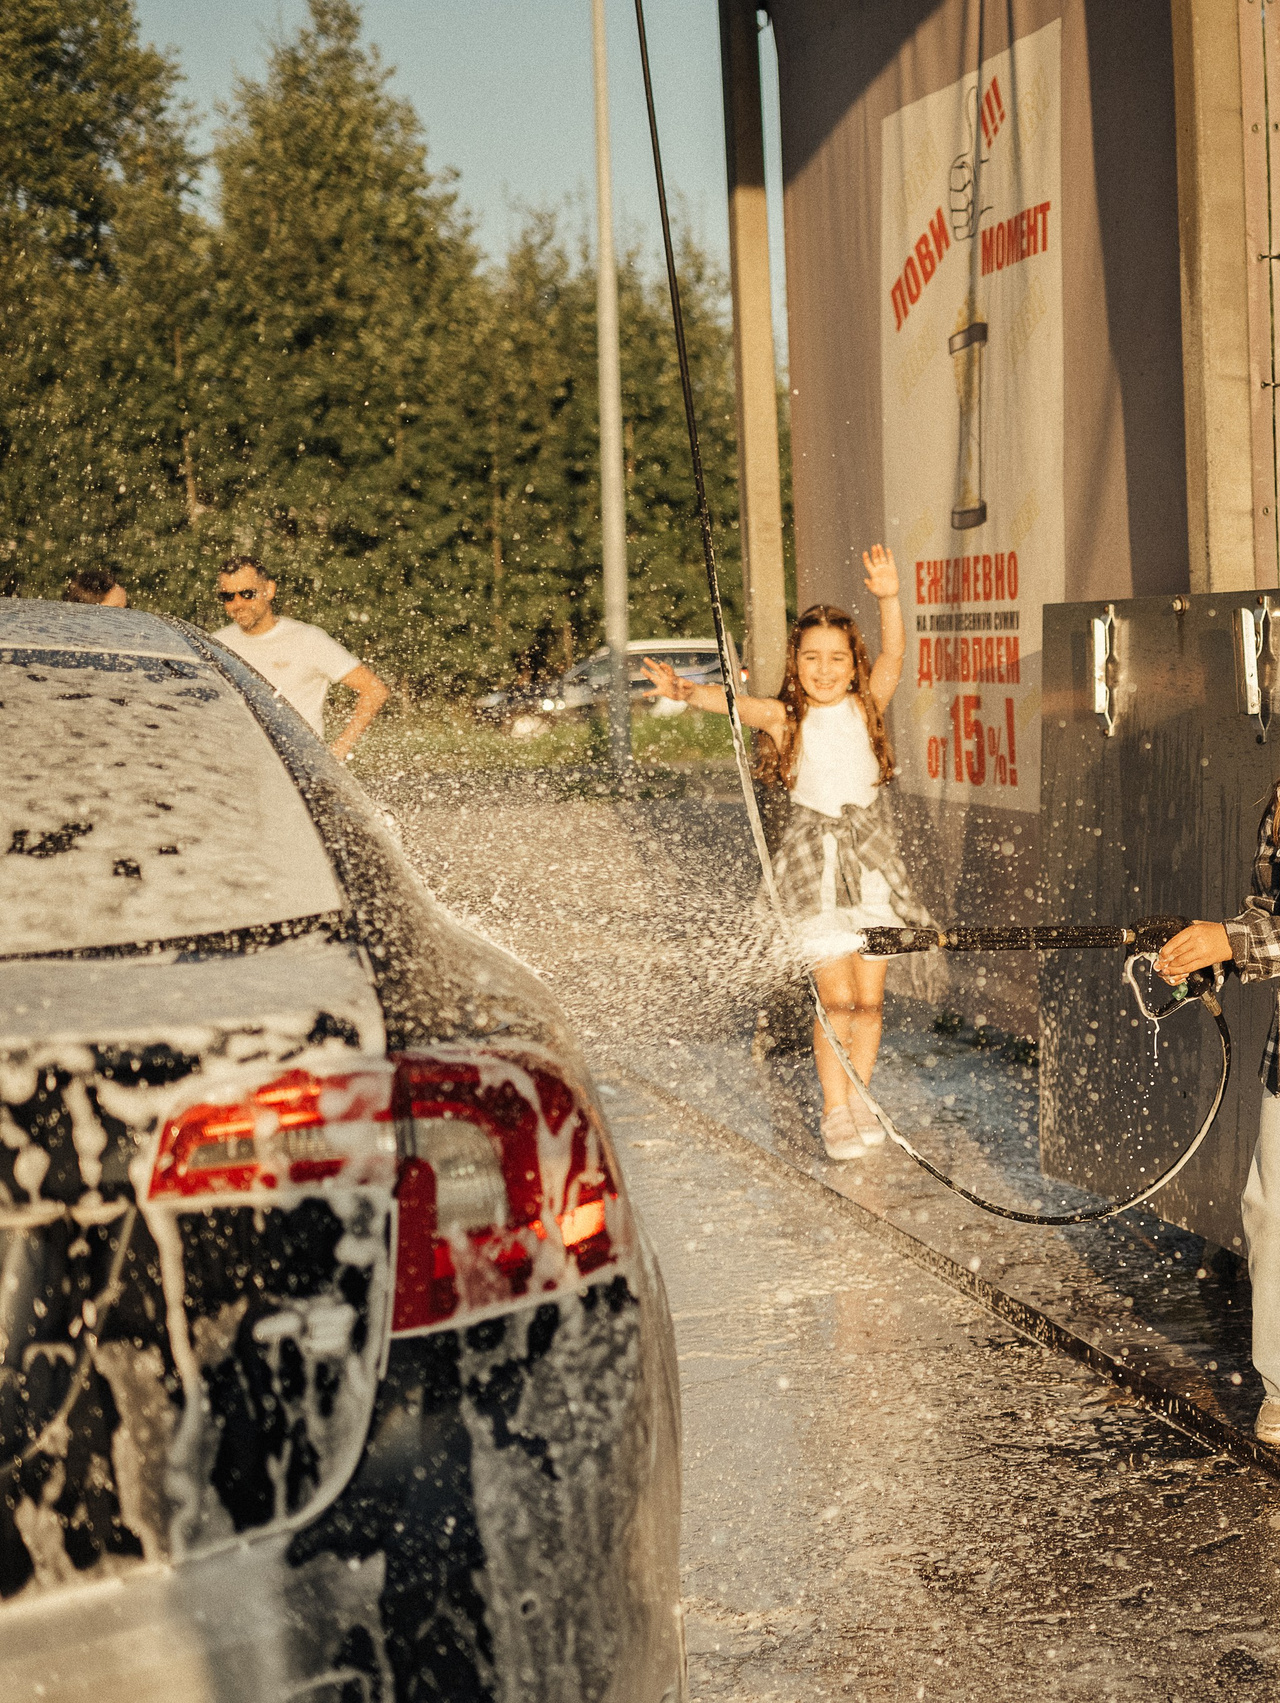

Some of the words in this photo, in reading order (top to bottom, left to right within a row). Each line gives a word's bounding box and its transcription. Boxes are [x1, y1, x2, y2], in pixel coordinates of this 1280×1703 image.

[890, 206, 951, 332] ЛОВИ
[981, 200, 1051, 277] МОМЕНТ
[916, 551, 1018, 611] ЕЖЕДНЕВНО
[917, 636, 1020, 689] ДОБАВЛЯЕМ
